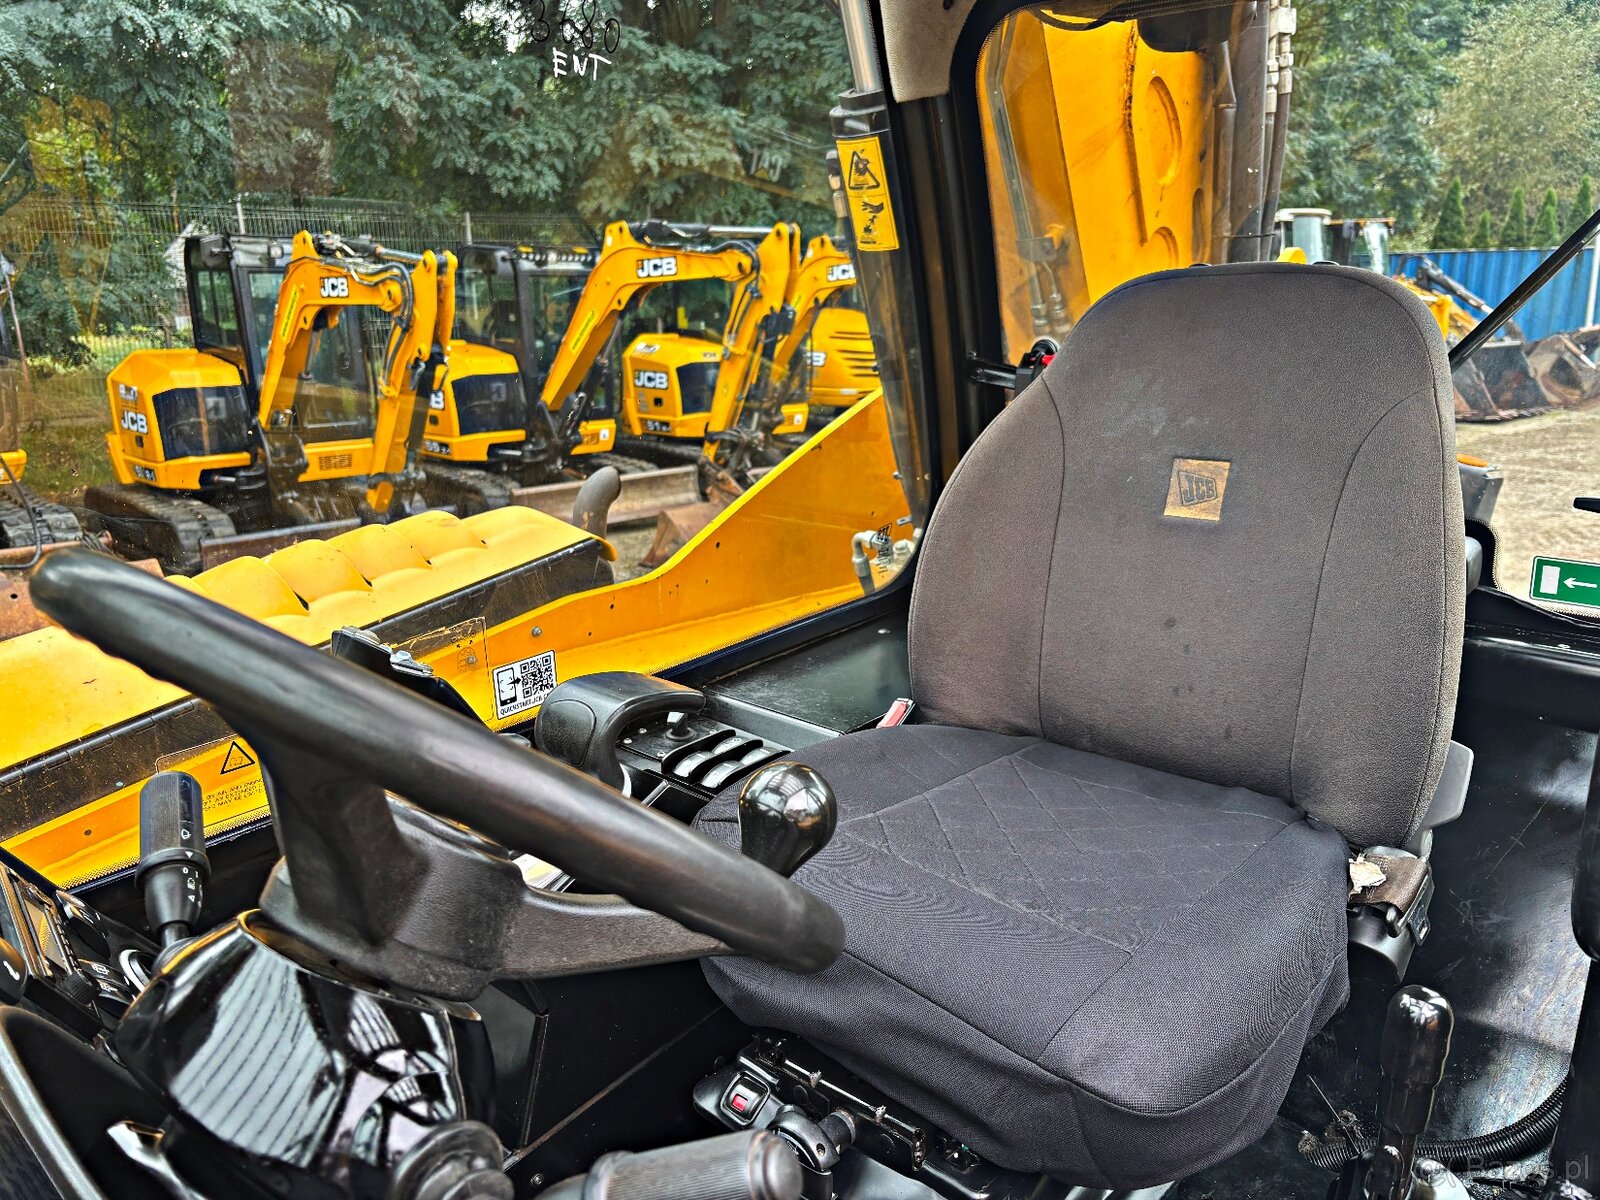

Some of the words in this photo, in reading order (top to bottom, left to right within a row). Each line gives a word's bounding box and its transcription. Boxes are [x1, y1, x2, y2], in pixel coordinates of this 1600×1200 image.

[637, 257, 678, 278] JCB
[827, 263, 856, 282] JC
[320, 277, 349, 298] JCB
[634, 370, 668, 389] JCB
[121, 409, 148, 434] JCB
[1179, 471, 1217, 507] JCB
